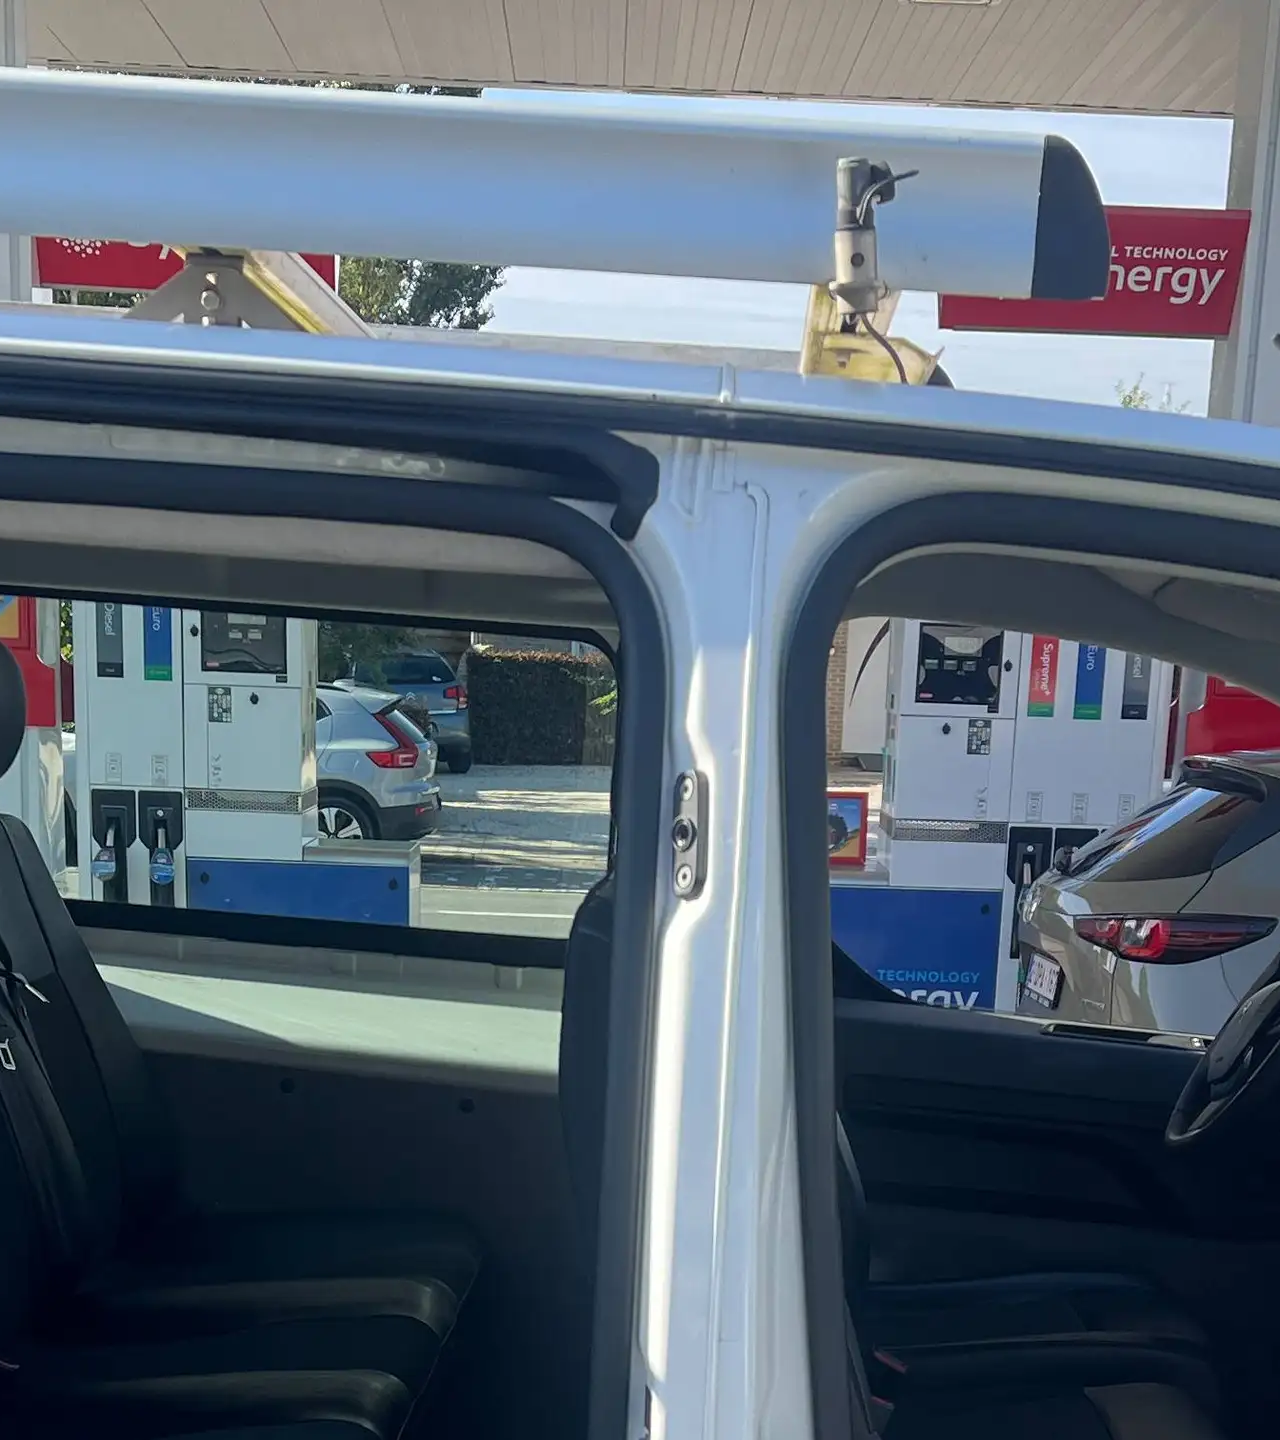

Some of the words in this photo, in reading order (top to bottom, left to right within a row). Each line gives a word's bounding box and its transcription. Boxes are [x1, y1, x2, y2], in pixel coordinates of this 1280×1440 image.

[1124, 246, 1229, 261] TECHNOLOGY
[104, 602, 116, 636] Diesel
[1086, 645, 1098, 671] Euro
[877, 969, 980, 984] TECHNOLOGY
